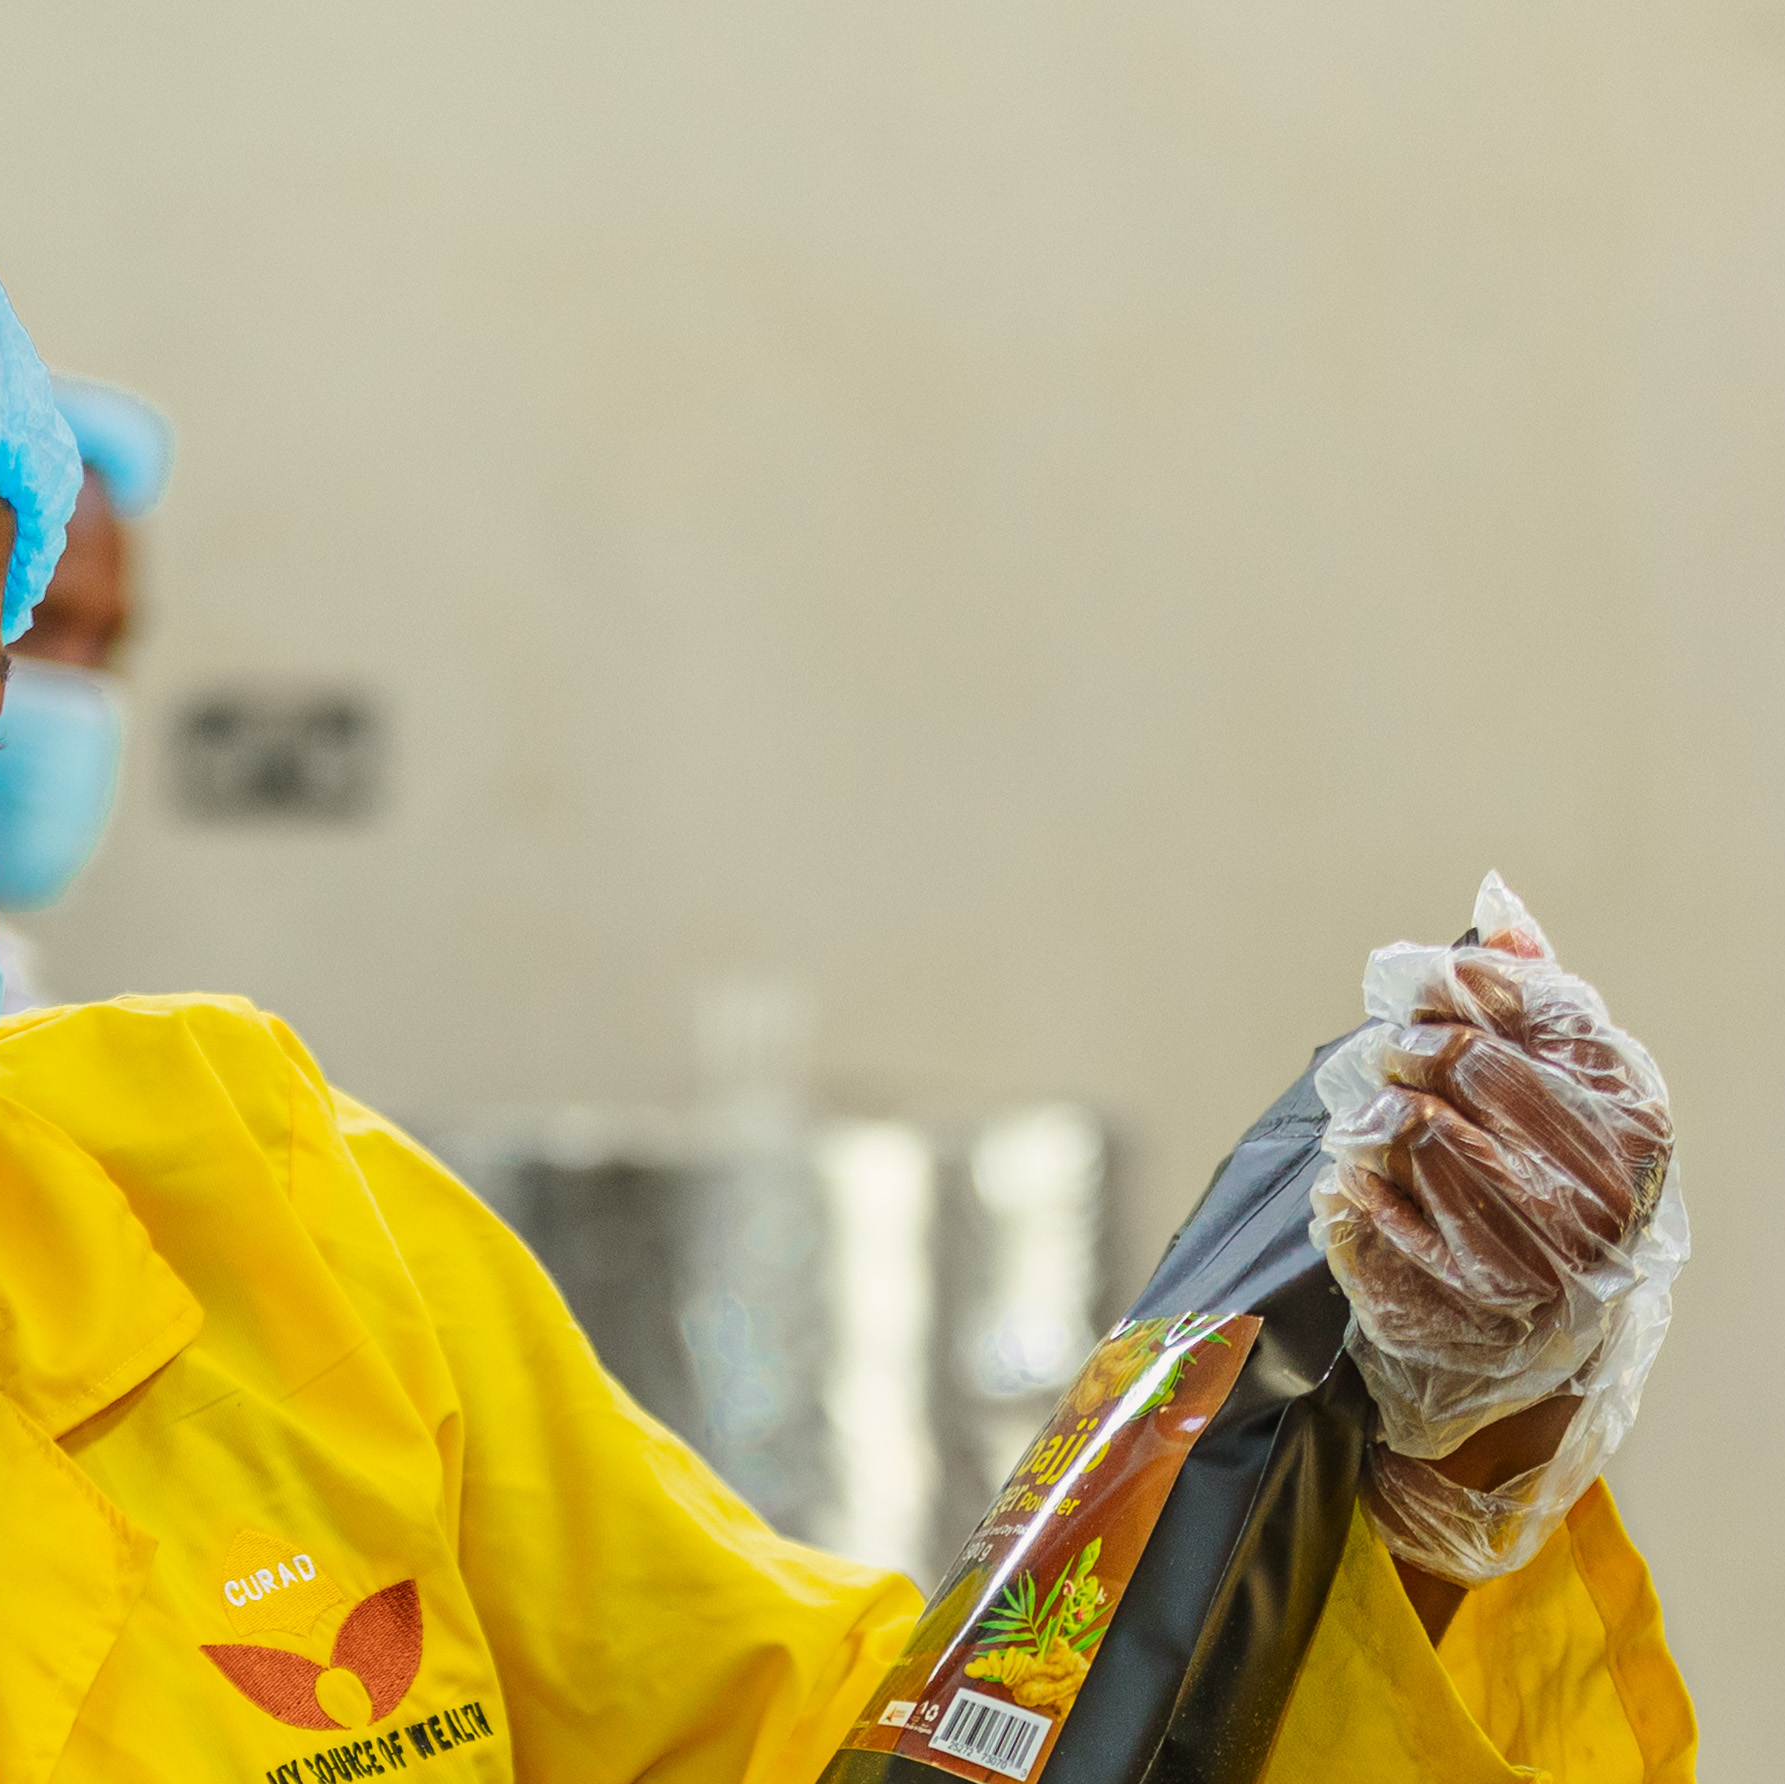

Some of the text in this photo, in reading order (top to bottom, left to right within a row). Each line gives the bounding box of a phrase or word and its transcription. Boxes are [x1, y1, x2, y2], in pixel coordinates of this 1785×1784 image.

[223, 1554, 317, 1607] CURAD
[376, 1730, 408, 1771] OF
[404, 1701, 494, 1760] WEALTH
[980, 1753, 1008, 1770] 73070
